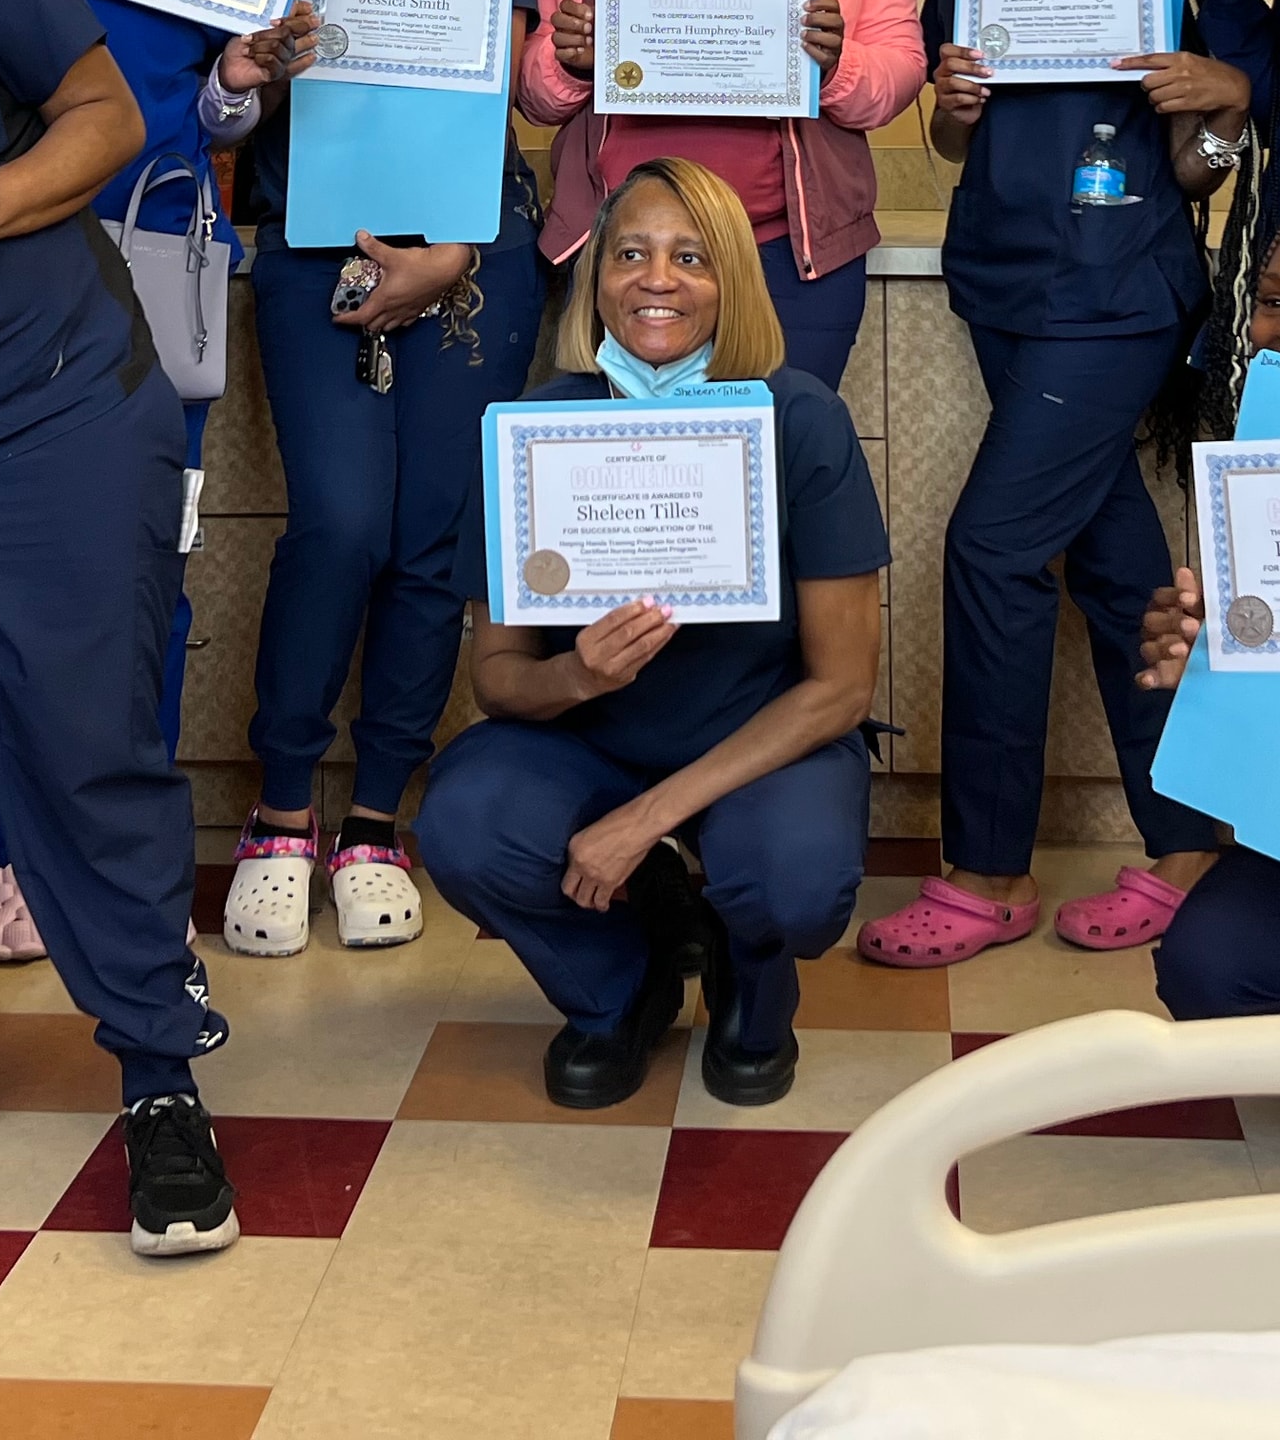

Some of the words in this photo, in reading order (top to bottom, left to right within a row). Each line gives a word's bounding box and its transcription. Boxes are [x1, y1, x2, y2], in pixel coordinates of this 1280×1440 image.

[630, 24, 681, 35] Charkerra
[685, 25, 776, 37] Humphrey-Bailey
[606, 455, 654, 463] CERTIFICATE
[570, 464, 704, 490] COMPLETION
[577, 505, 645, 521] Sheleen
[651, 502, 699, 519] Tilles
